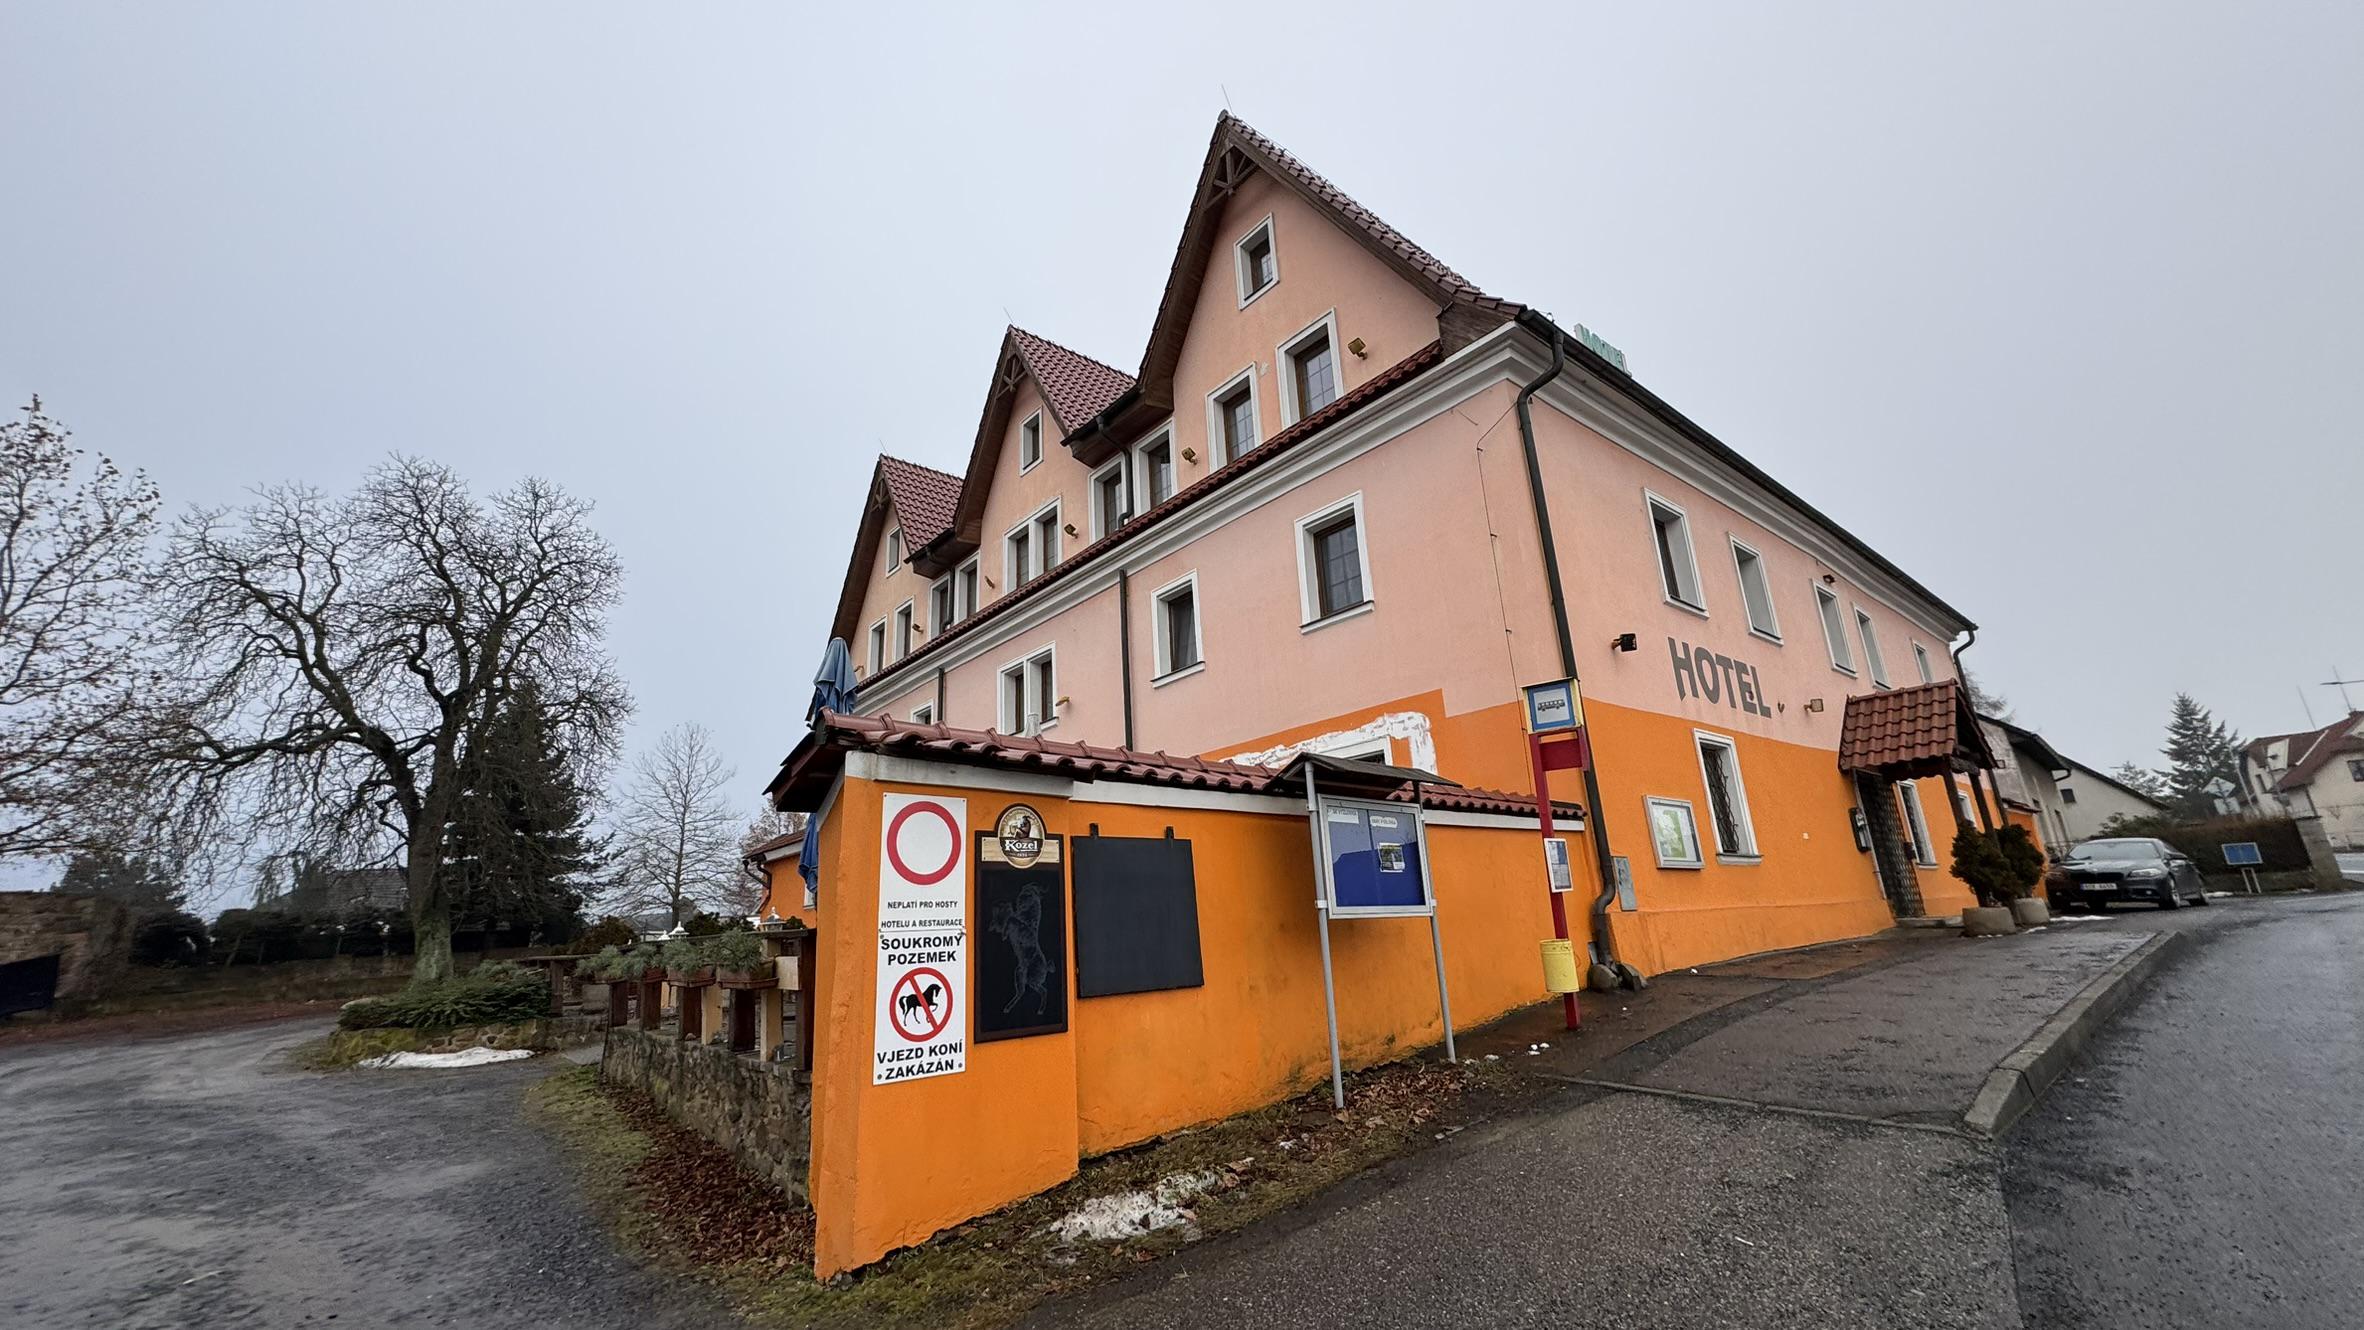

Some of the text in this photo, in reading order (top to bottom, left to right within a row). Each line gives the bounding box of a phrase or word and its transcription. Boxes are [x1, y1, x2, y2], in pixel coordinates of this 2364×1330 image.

[1667, 636, 1772, 719] HOTEL
[1005, 839, 1039, 852] Kozel
[887, 900, 958, 910] NEPLATÍ PRO HOSTY
[881, 918, 963, 929] HOTELU A RESTAURACE
[888, 950, 957, 966] POZEMEK
[877, 1038, 963, 1065] VJEZD KONÍ
[885, 1058, 955, 1080] ZAKÁZÁN
